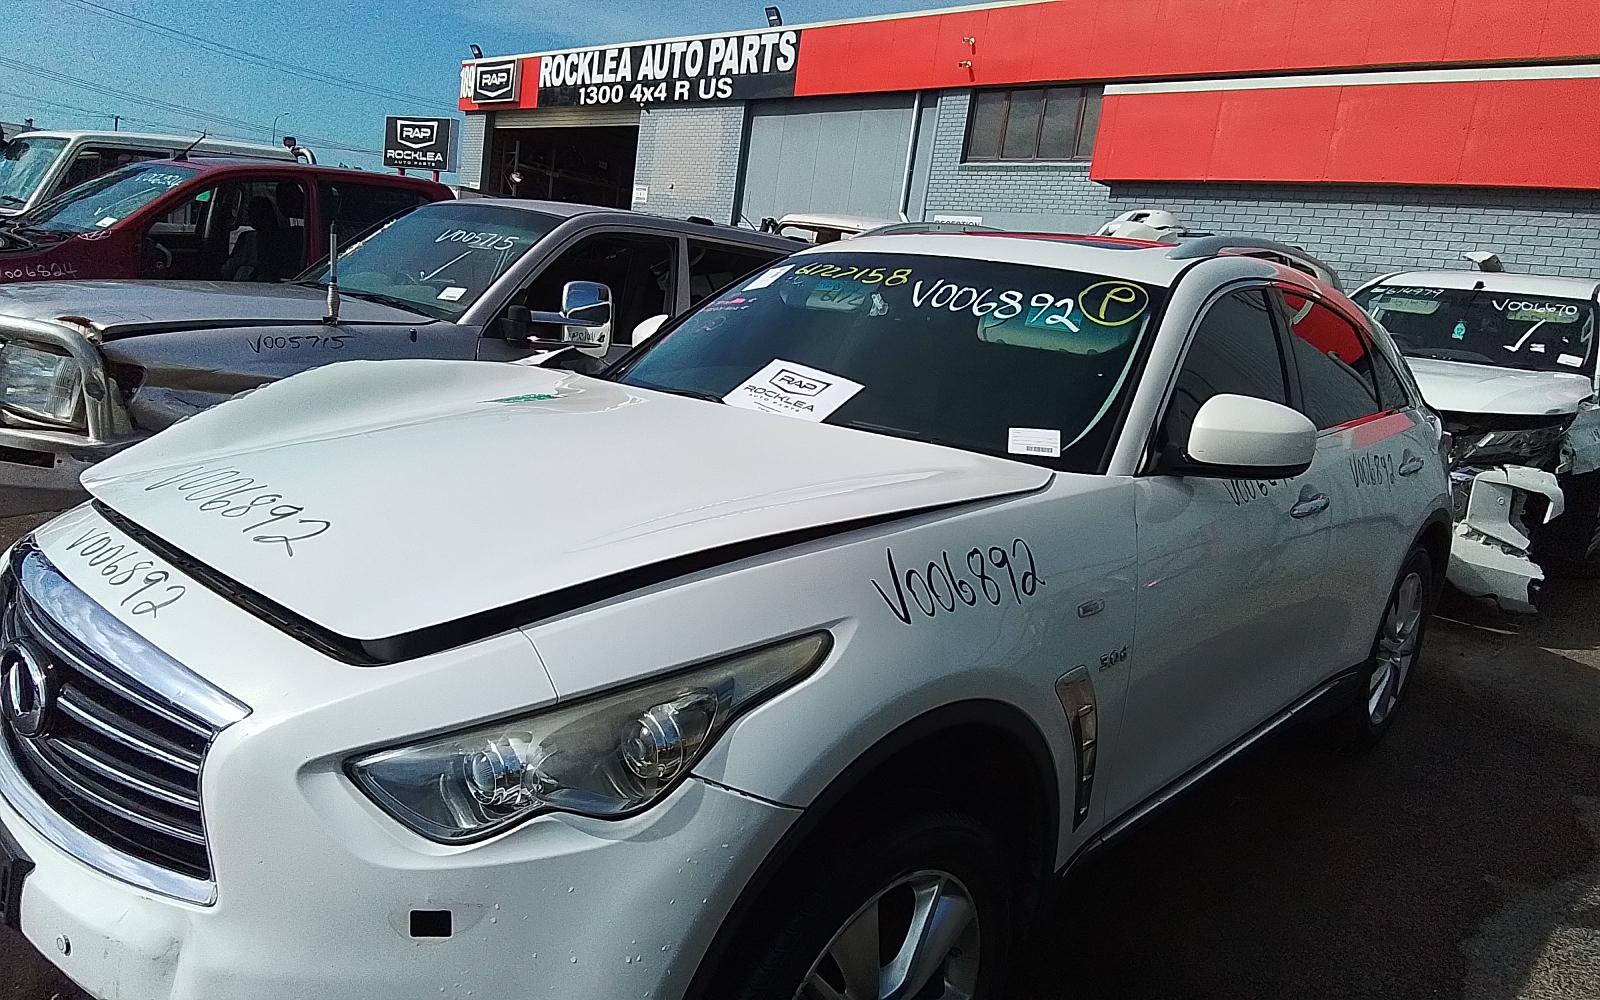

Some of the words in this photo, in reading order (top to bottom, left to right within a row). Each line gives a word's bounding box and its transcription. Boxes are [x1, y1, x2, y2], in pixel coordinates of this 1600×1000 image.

[539, 48, 633, 88] ROCKLEA
[637, 40, 704, 81] AUTO
[707, 31, 797, 76] PARTS
[460, 65, 476, 98] 189
[482, 72, 508, 86] RAP
[578, 84, 624, 105] 1300
[629, 81, 668, 102] 4x4
[674, 80, 690, 101] R
[699, 77, 733, 100] US
[402, 127, 431, 139] RAP
[386, 149, 444, 162] ROCKLEA
[435, 229, 520, 250] V005715
[0, 262, 79, 279] 006824
[912, 279, 1081, 333] V006892
[1492, 299, 1578, 316] V006670
[247, 335, 354, 354] V005715
[778, 375, 818, 391] RAP
[743, 384, 815, 412] ROCKLEA
[145, 466, 331, 557] V006892
[66, 527, 186, 619] V006892
[871, 537, 1047, 625] V006892
